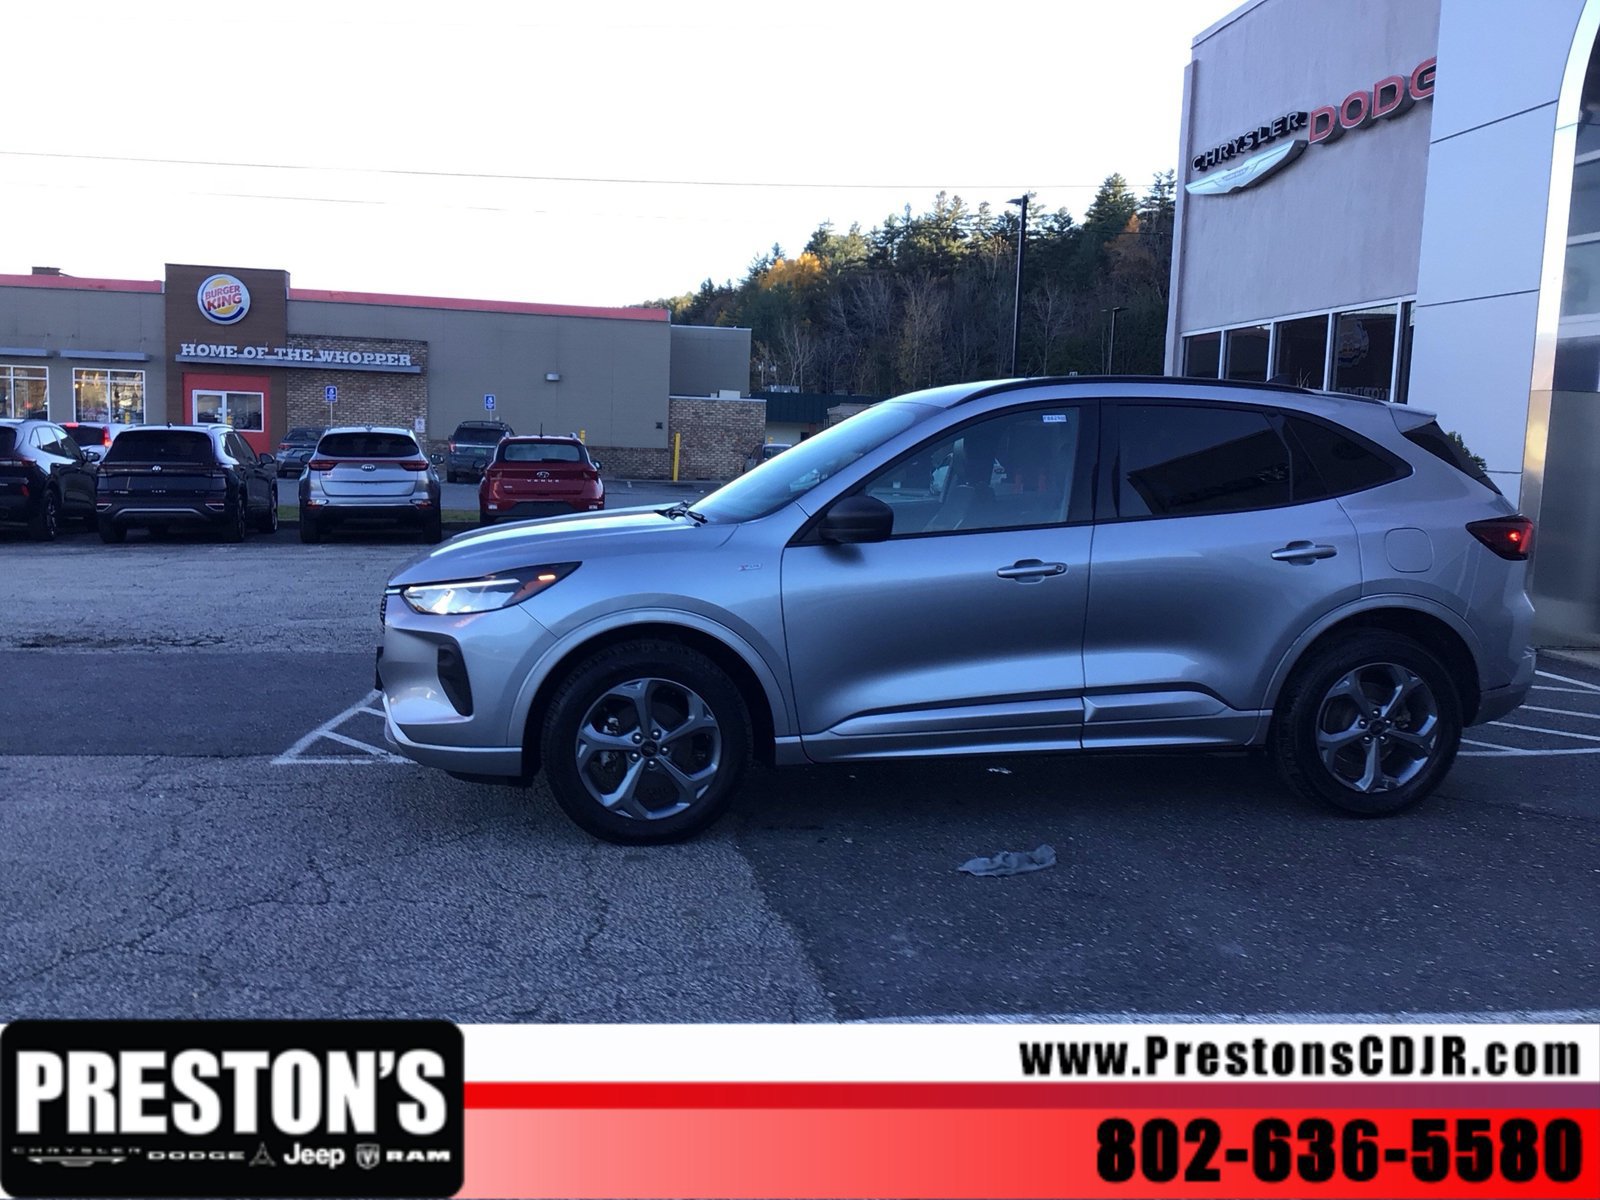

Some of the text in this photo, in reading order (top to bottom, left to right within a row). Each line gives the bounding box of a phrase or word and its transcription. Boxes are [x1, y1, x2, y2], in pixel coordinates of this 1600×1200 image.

[1192, 111, 1308, 172] CHRYSLER
[205, 285, 240, 300] BURGER
[207, 293, 242, 311] KING
[181, 343, 411, 366] HOME OF THE WHOPPER
